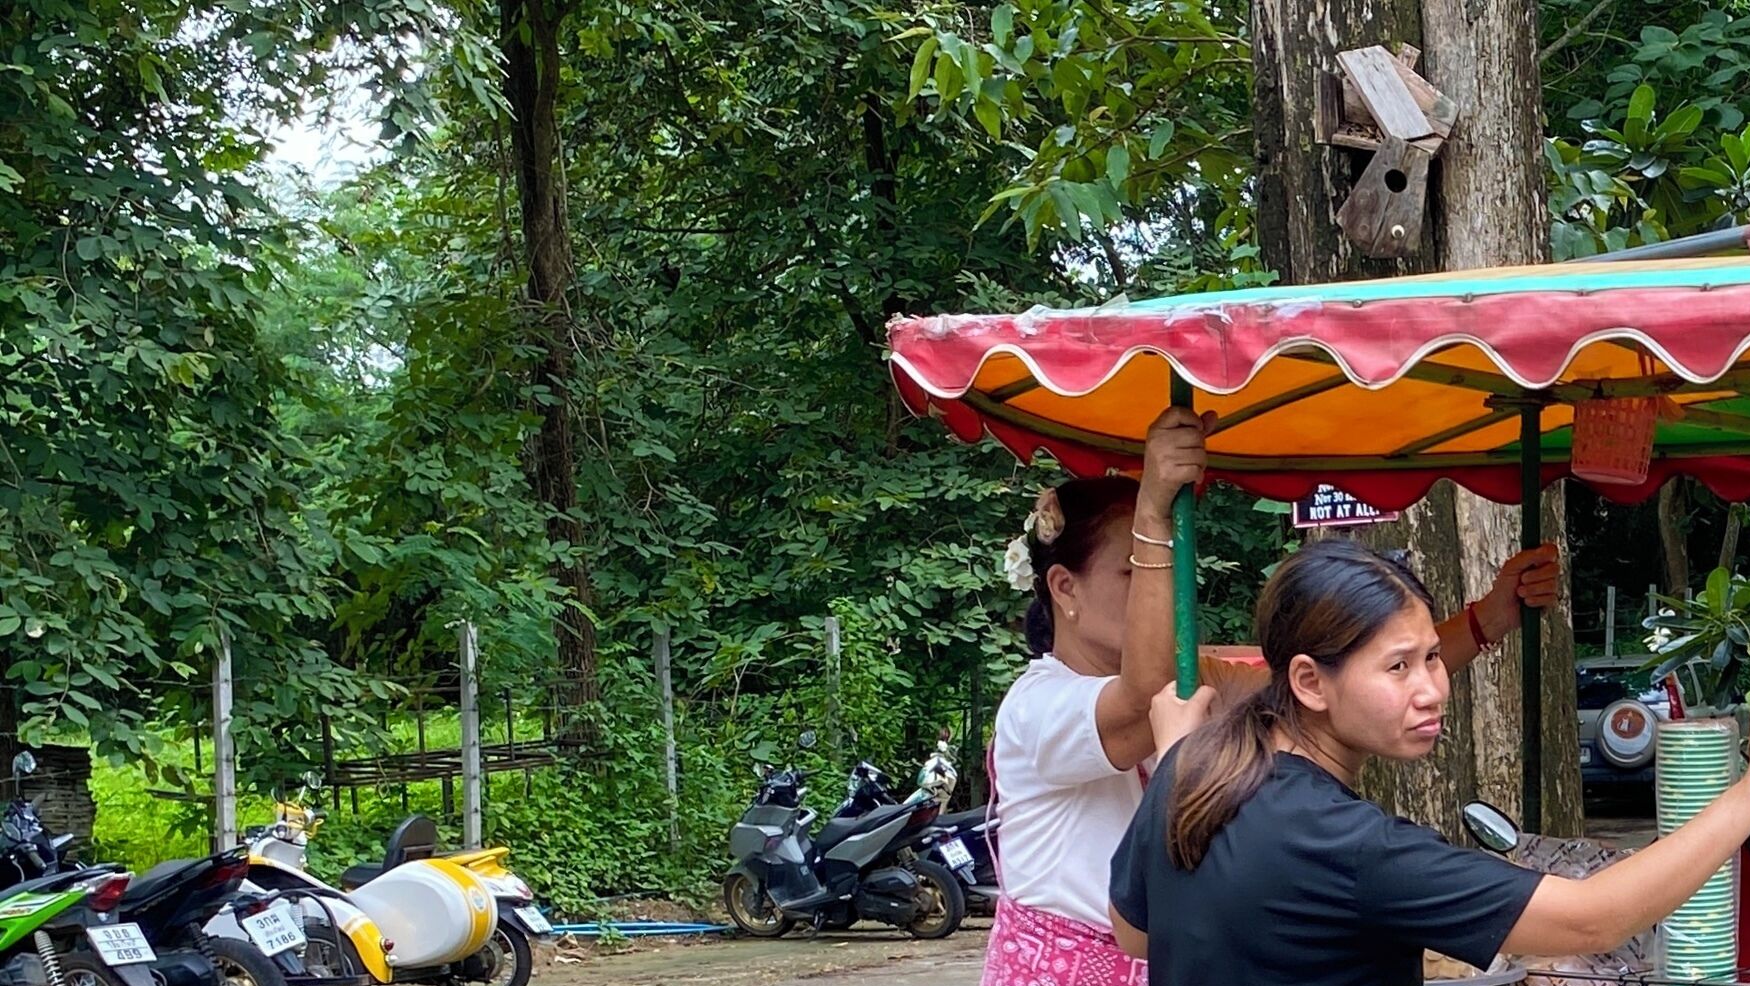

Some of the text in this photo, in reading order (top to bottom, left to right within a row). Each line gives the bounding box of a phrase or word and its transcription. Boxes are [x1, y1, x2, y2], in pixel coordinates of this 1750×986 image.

[1333, 491, 1344, 502] 30
[1309, 506, 1332, 520] NOT
[1336, 504, 1351, 518] AT
[266, 932, 296, 949] 7186
